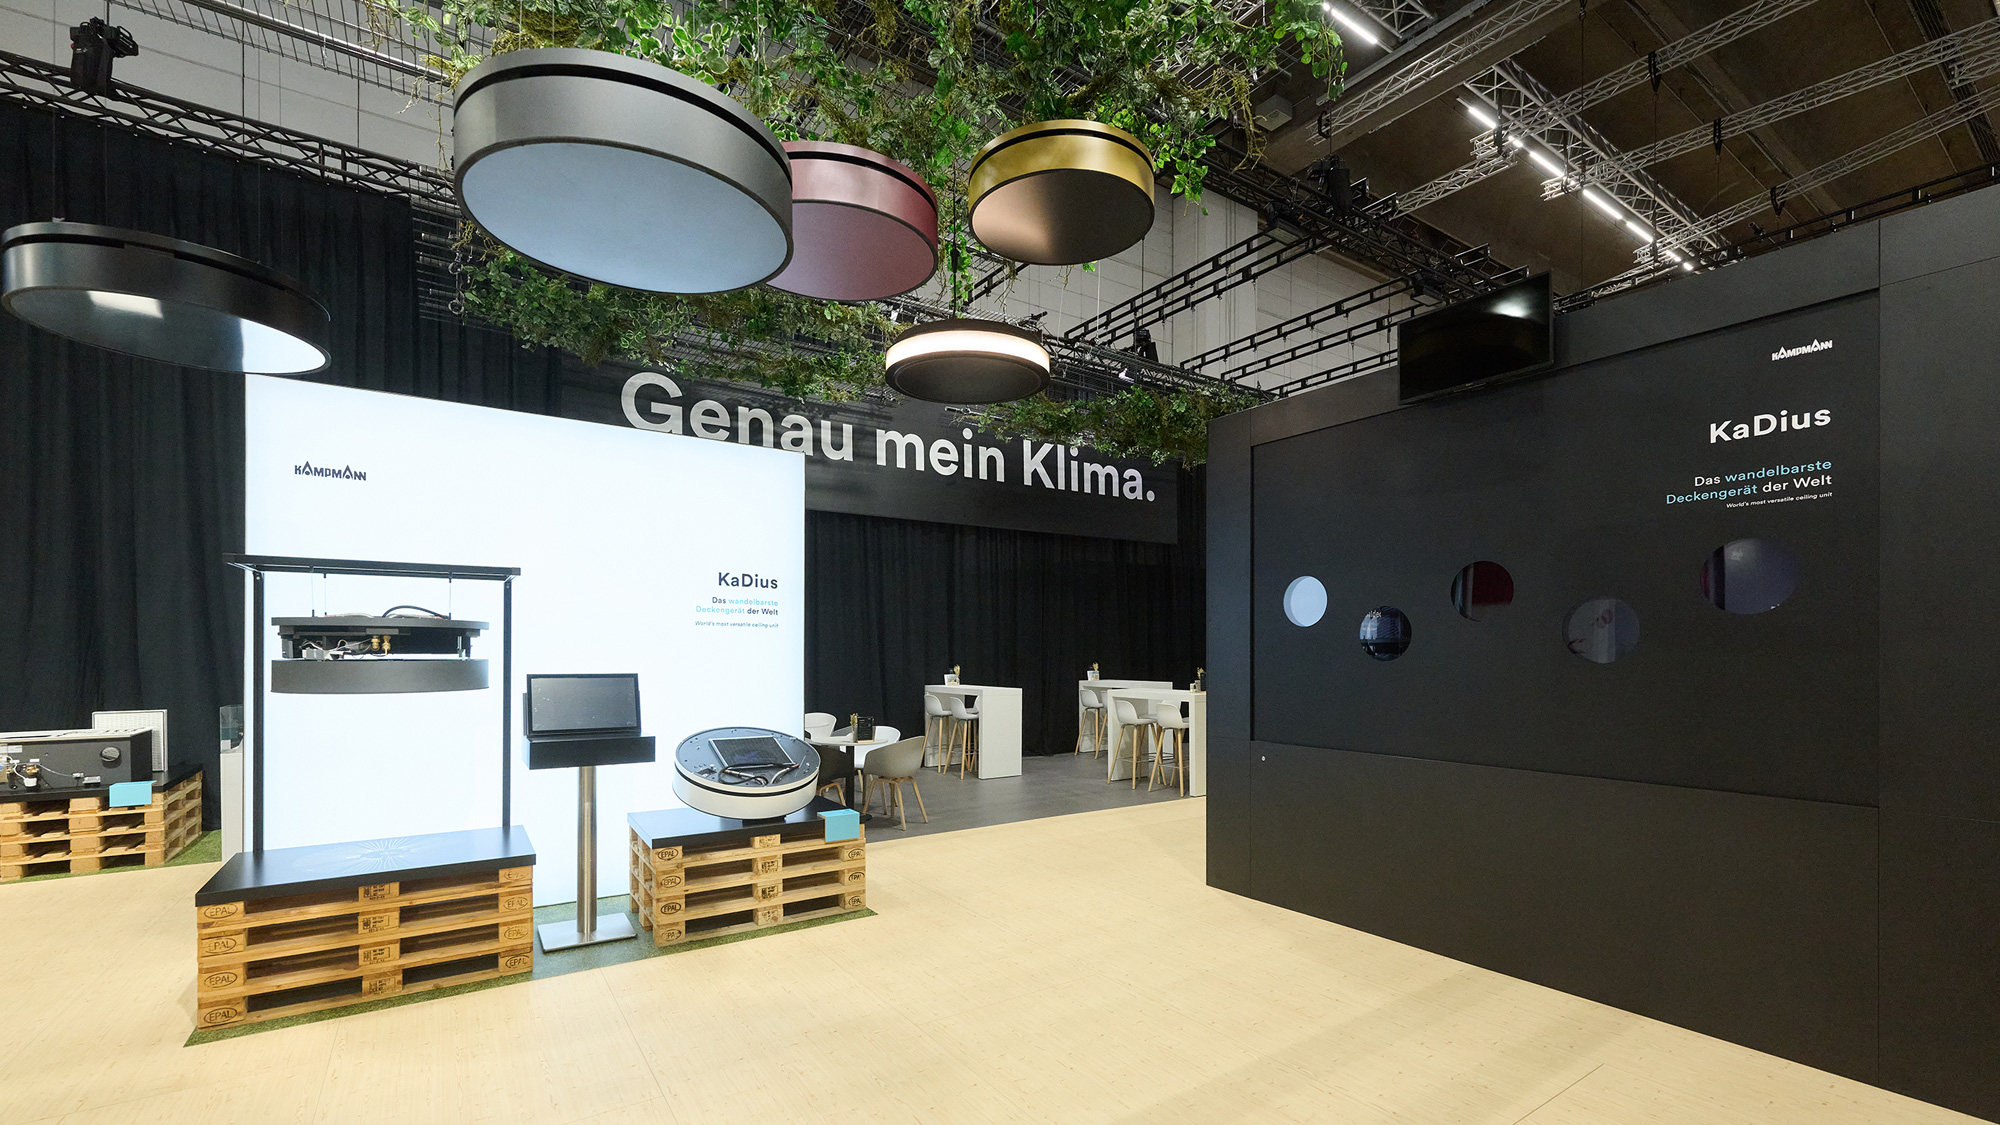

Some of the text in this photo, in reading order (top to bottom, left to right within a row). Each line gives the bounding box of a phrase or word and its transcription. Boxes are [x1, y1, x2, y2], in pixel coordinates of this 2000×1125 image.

[1771, 339, 1833, 361] KAMPMANN
[1709, 408, 1832, 444] KaDius
[620, 372, 1156, 502] Genau mein Klima.
[294, 460, 367, 481] KAMPMANN
[1694, 460, 1832, 487] Das wandelbarste
[1666, 475, 1832, 505] Deckengerät der Welt
[1767, 496, 1794, 504] versatile
[1795, 494, 1817, 502] ceiling
[718, 572, 778, 589] KaDius
[696, 606, 745, 615] Deckengerät
[747, 607, 760, 615] der
[729, 599, 778, 607] wandelbarste
[209, 906, 234, 917] EPAL
[209, 974, 233, 986] EPAL
[209, 1010, 233, 1022] EPAL
